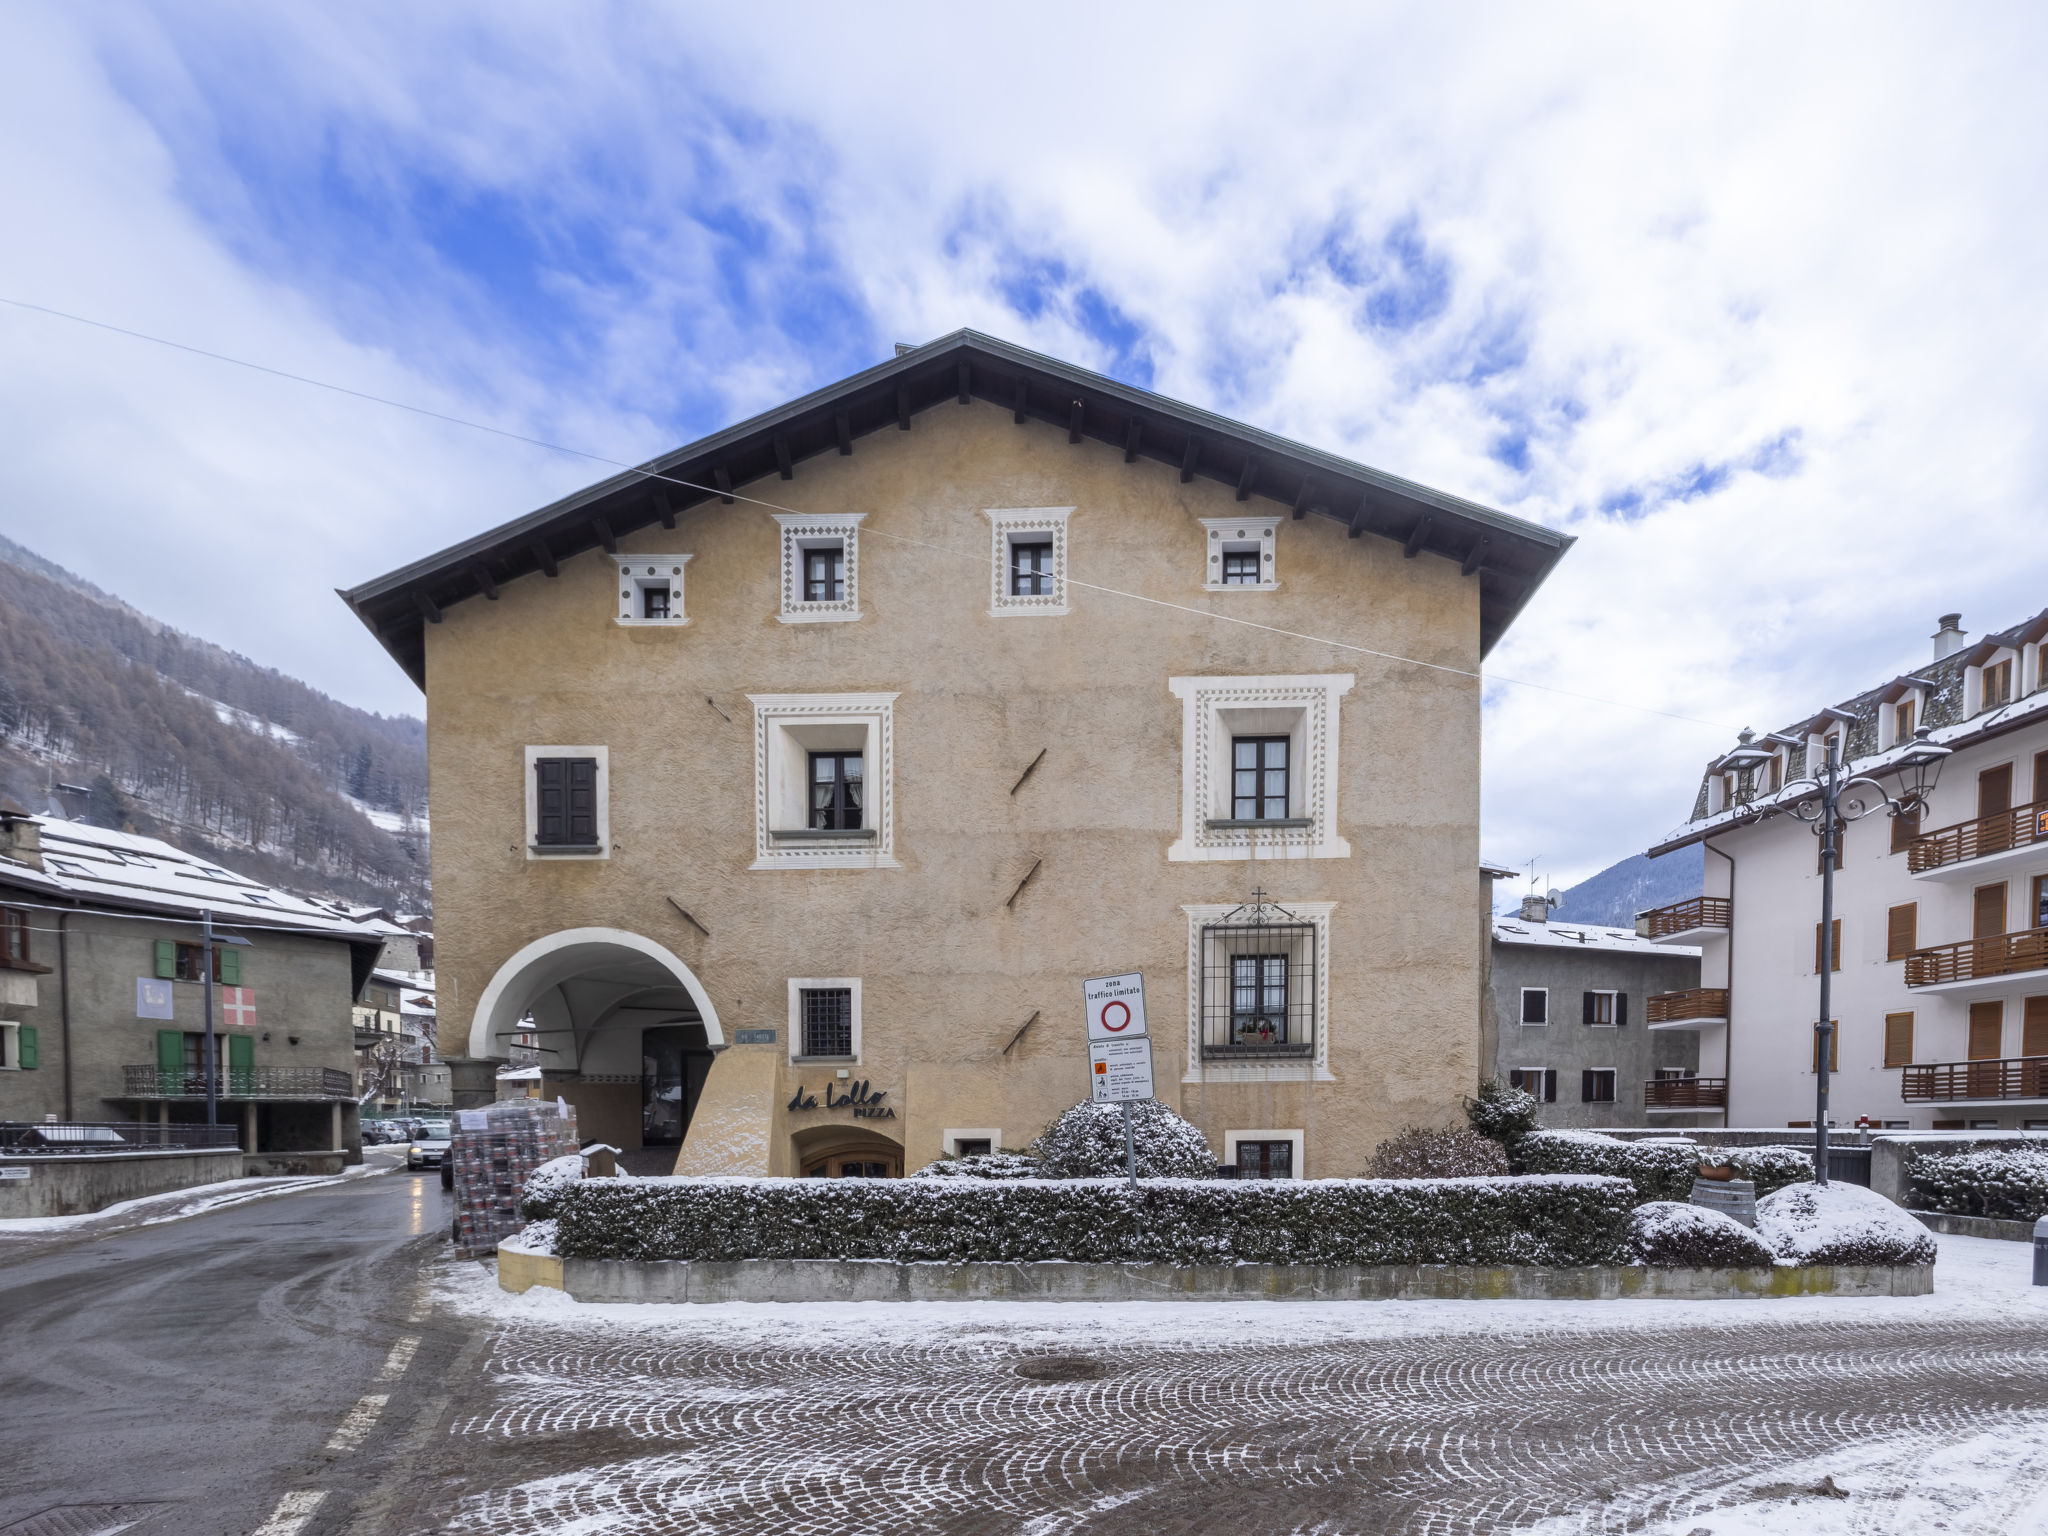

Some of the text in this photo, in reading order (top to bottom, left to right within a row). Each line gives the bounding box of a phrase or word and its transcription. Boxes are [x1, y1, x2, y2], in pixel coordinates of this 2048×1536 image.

[1105, 980, 1120, 988] zona
[1088, 987, 1140, 1000] traffico limitato
[787, 1085, 818, 1111] da
[853, 1107, 896, 1118] PIZZA
